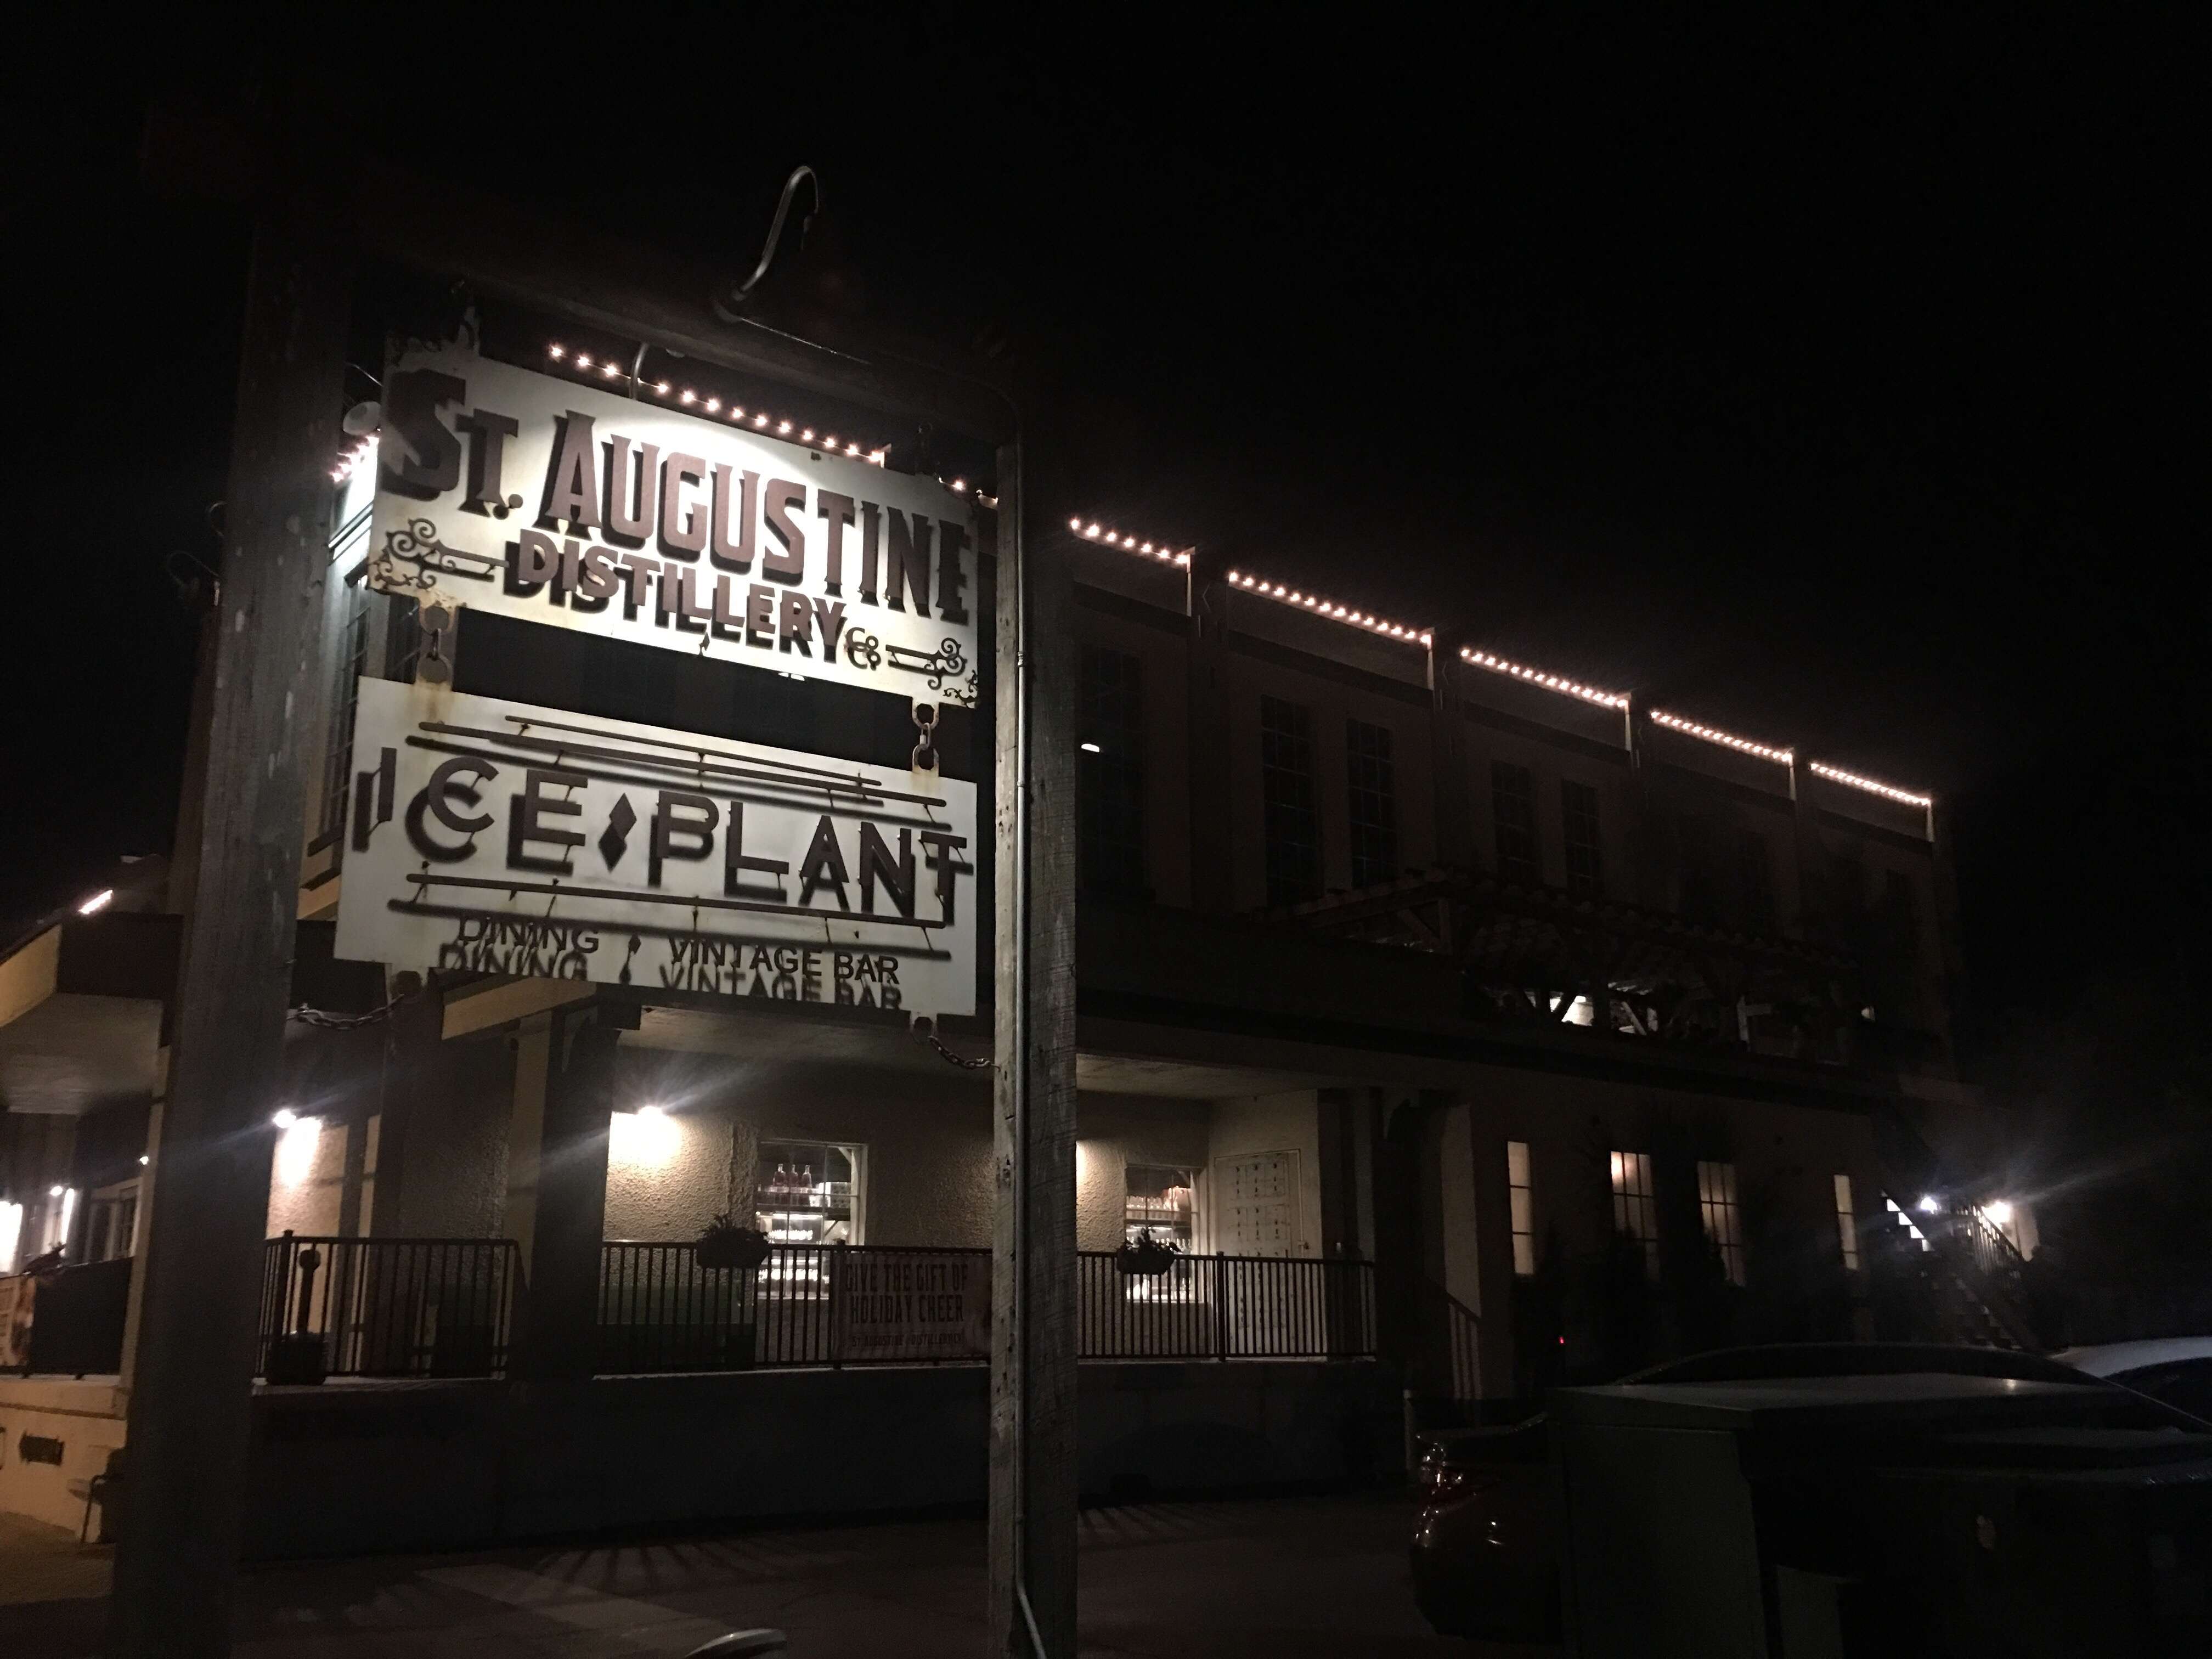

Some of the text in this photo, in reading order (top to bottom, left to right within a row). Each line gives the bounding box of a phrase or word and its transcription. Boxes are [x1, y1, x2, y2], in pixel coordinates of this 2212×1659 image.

[540, 409, 969, 622] AUGUSTINE
[516, 528, 847, 650] DISTILLERY
[374, 747, 967, 902] ICE PLANT
[457, 917, 900, 985] DINING VINTAGE BAR
[846, 1263, 968, 1291] GIVE THE GIFT OF
[851, 1295, 964, 1323] HOLIDAY CHEER
